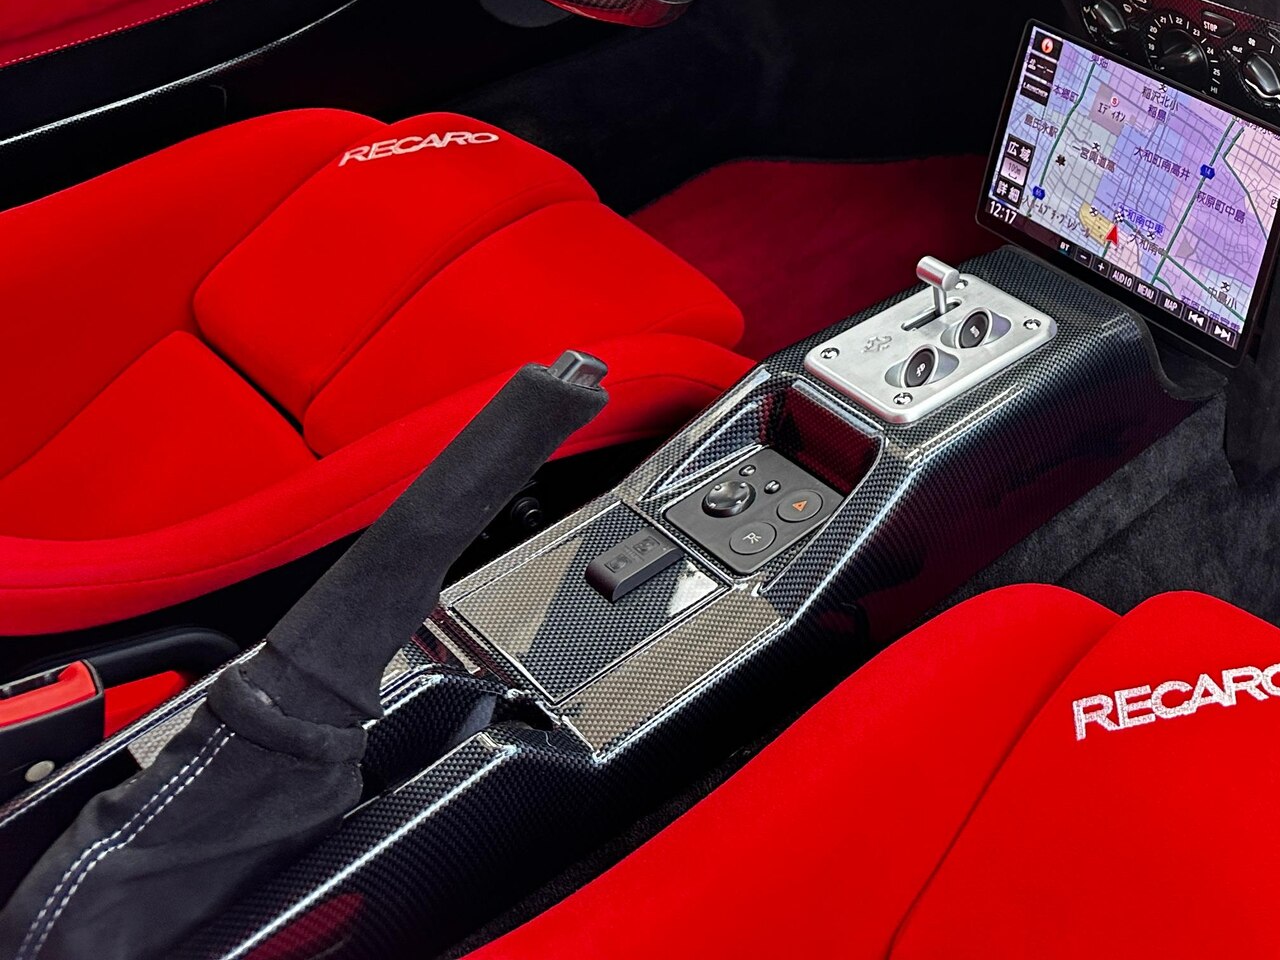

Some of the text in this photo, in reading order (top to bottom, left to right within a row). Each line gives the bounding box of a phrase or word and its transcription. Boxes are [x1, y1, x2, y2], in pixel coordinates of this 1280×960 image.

[1203, 20, 1218, 32] STOP
[1142, 86, 1179, 112] 稲沢北小
[338, 131, 499, 167] RECARO
[1007, 140, 1032, 162] 広域
[996, 180, 1021, 203] 詳細
[989, 200, 1017, 224] 12:17
[1060, 241, 1070, 251] BT
[1112, 270, 1132, 288] AUDIO
[1137, 283, 1155, 300] MENU
[1164, 298, 1178, 312] MAP
